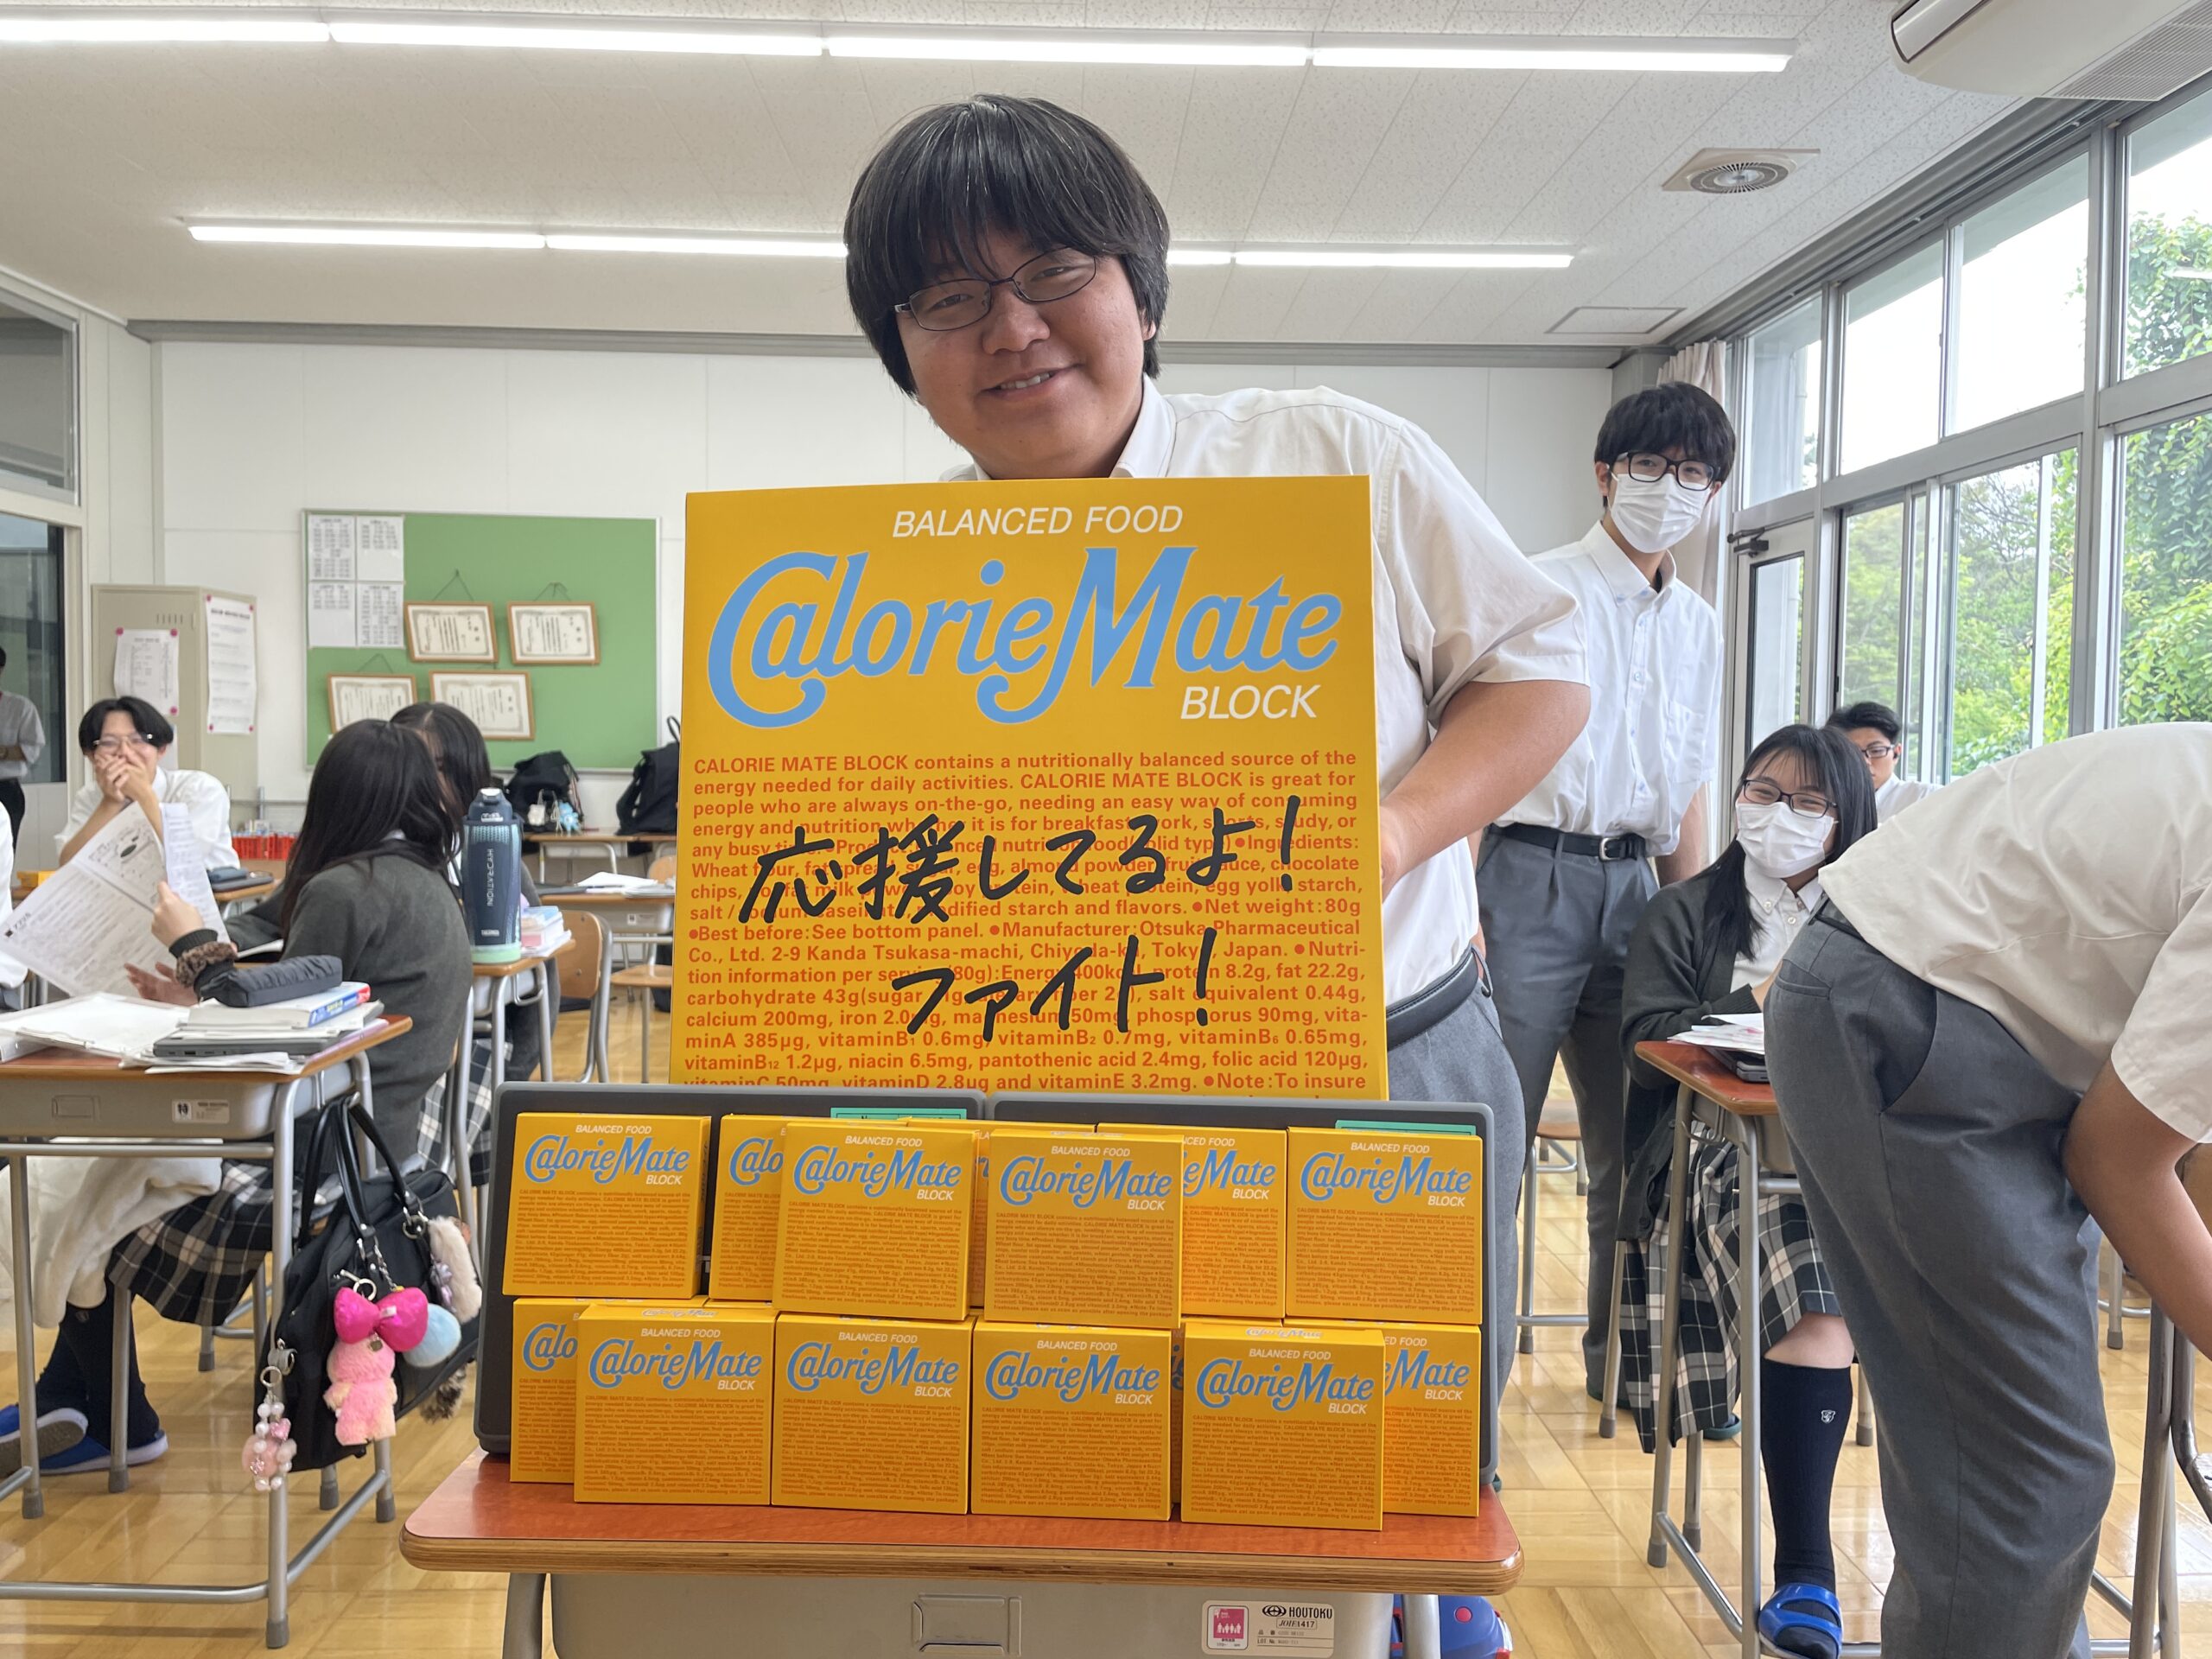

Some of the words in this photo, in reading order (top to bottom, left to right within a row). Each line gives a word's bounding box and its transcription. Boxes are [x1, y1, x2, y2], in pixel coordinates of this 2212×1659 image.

[892, 505, 1071, 537] BALANCED
[1085, 505, 1184, 533] FOOD
[708, 546, 1344, 729] CalorieMate
[1180, 684, 1321, 720] BLOCK
[693, 756, 774, 772] CALORIE
[781, 756, 835, 772] MATE
[843, 754, 907, 771] BLOCK
[914, 754, 994, 770] contains
[1001, 757, 1011, 769] a
[1016, 752, 1132, 772] nutritionally
[1141, 751, 1224, 766] balanced
[1232, 753, 1293, 766] source
[1301, 749, 1319, 765] of
[1327, 749, 1355, 765] the
[695, 781, 755, 798] energy
[762, 776, 831, 792] needed
[838, 776, 862, 791] for
[871, 775, 914, 795] daily
[923, 775, 1013, 791] activities.
[1020, 773, 1104, 789] CALORIE
[1113, 772, 1170, 788] MATE
[1175, 772, 1243, 787] BLOCK
[1249, 772, 1263, 786] is
[1272, 772, 1320, 791] great
[1329, 770, 1355, 785] for
[693, 798, 753, 819] people
[760, 798, 800, 814] who
[809, 801, 836, 813] are
[843, 797, 907, 817] always
[914, 795, 1011, 816] on-the-go,
[1020, 794, 1096, 815] needing
[1103, 798, 1123, 809] an
[1130, 797, 1172, 813] easy
[1180, 796, 1220, 812] way
[1227, 792, 1244, 807] of
[1251, 791, 1357, 811] conuming
[693, 823, 753, 839] energy
[760, 818, 793, 834] and
[800, 818, 881, 834] nutrition
[971, 817, 983, 832] it
[990, 817, 1004, 831] is
[1011, 816, 1035, 831] for
[1338, 816, 1355, 828] or
[693, 845, 722, 861] any
[728, 841, 771, 861] busy
[691, 862, 747, 878] Wheat
[691, 883, 741, 903] chips,
[1298, 876, 1362, 895] starch,
[691, 905, 722, 920] salt
[1007, 900, 1068, 917] starch
[1075, 900, 1109, 916] and
[1116, 899, 1187, 915] flavors.
[1205, 899, 1239, 914] Net
[852, 924, 921, 939] bottom
[928, 923, 983, 943] panel.
[1211, 919, 1358, 936] Pharmaceutical
[688, 947, 722, 966] Co.,
[729, 947, 764, 963] Ltd.
[772, 946, 802, 962] 2-9
[807, 946, 868, 962] Kanda
[874, 944, 1023, 964] Tsukasa-machi,
[1224, 941, 1287, 962] Japan.
[1308, 941, 1365, 957] Nutri-
[688, 969, 722, 983] tion
[728, 967, 836, 983] information
[842, 970, 871, 987] per
[1225, 964, 1270, 984] 8.2g,
[1275, 963, 1300, 979] fat
[1308, 963, 1365, 983] 22.2g,
[686, 989, 816, 1010] carbohydrate
[823, 988, 923, 1009] 43g(sugar
[1149, 987, 1185, 1002] salt
[1306, 985, 1365, 1005] 0.44g,
[686, 1012, 757, 1027] calcium
[764, 1012, 833, 1032] 200mg,
[840, 1012, 876, 1027] iron
[1137, 1008, 1251, 1028] phosporus
[1258, 1007, 1319, 1027] 90mg,
[1325, 1008, 1367, 1023] vita-
[686, 1033, 736, 1048] minA
[921, 1031, 990, 1051] 0.6mg,
[1103, 1030, 1172, 1050] 0.7mg,
[1286, 1028, 1367, 1048] 0.65mg,
[849, 1055, 904, 1069] niacin
[909, 1053, 973, 1073] 6.5mg,
[978, 1052, 1092, 1072] pantothenic
[1097, 1052, 1137, 1068] acid
[1142, 1052, 1206, 1071] 2.4mg,
[1211, 1052, 1253, 1067] folic
[1258, 1052, 1298, 1066] acid
[995, 1074, 1032, 1090] and
[1037, 1074, 1125, 1090] vitaminE
[1130, 1073, 1198, 1093] 3.2mg.
[1305, 1073, 1367, 1088] insure
[575, 1124, 623, 1135] BALANCED
[626, 1125, 652, 1135] FOOD
[845, 1136, 893, 1147] BALANCED
[895, 1138, 922, 1147] FOOD
[1208, 1137, 1236, 1147] FOOD
[1351, 1142, 1400, 1153] BALANCED
[1402, 1144, 1430, 1154] FOOD
[1051, 1146, 1099, 1156] BALANCED
[1103, 1147, 1130, 1157] FOOD
[645, 1174, 682, 1185] BLOCK
[917, 1190, 953, 1201] BLOCK
[1232, 1188, 1269, 1199] BLOCK
[1127, 1199, 1165, 1211] BLOCK
[1428, 1195, 1465, 1207] BLOCK
[641, 1328, 690, 1338] BALANCED
[693, 1329, 721, 1338] FOOD
[838, 1332, 887, 1342] BALANCED
[890, 1333, 918, 1344] FOOD
[1037, 1340, 1087, 1351] BALANCED
[1090, 1341, 1117, 1351] FOOD
[1399, 1337, 1427, 1347] FOOD
[1249, 1348, 1300, 1359] BALANCED
[1303, 1350, 1332, 1361] FOOD
[717, 1380, 756, 1390] BLOCK
[914, 1386, 951, 1397] BLOCK
[1115, 1393, 1153, 1404] BLOCK
[1425, 1389, 1463, 1401] BLOCK
[1328, 1402, 1368, 1414] BLOCK
[1289, 1606, 1332, 1619] HOUTOKU
